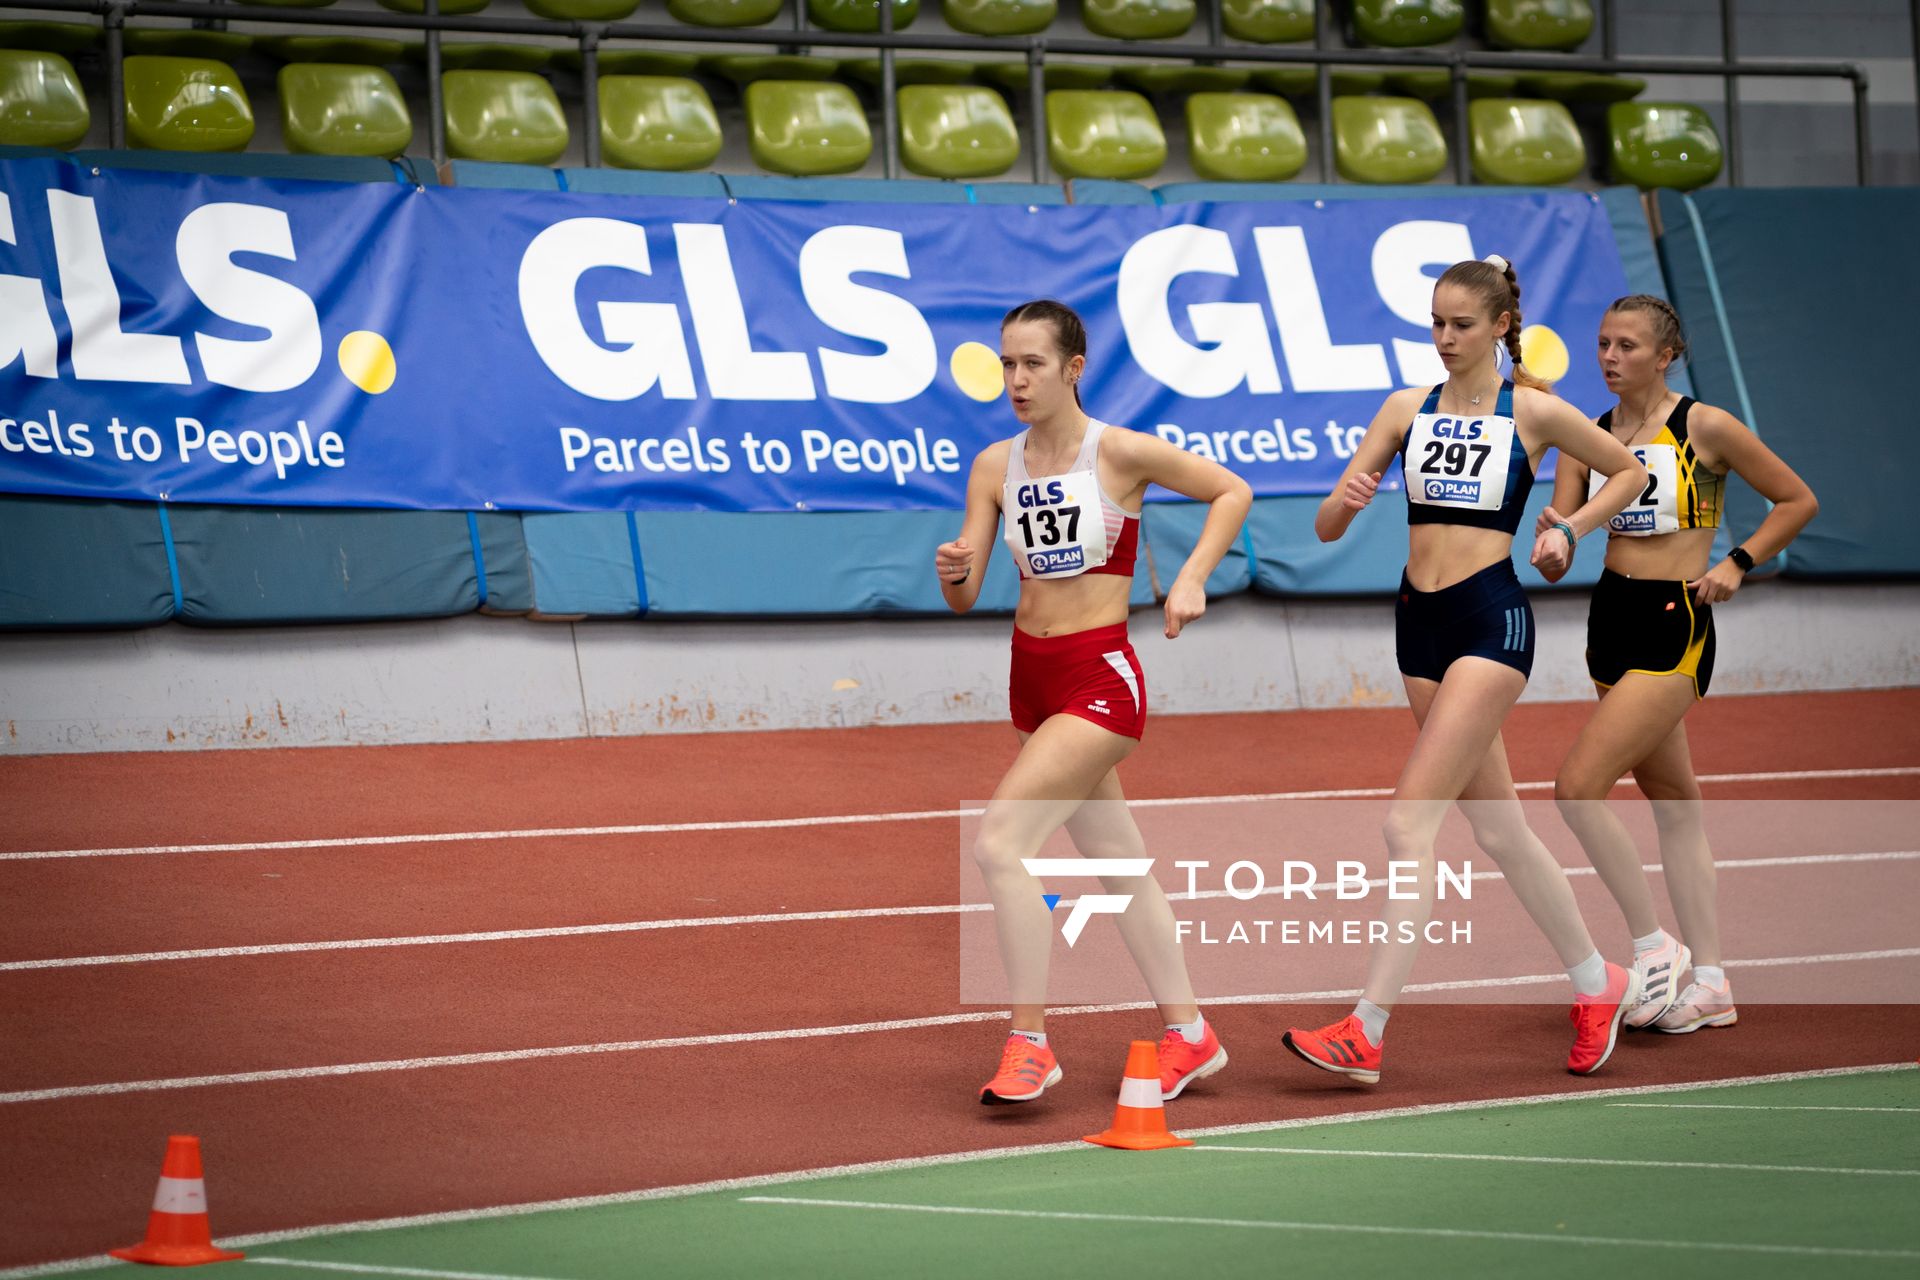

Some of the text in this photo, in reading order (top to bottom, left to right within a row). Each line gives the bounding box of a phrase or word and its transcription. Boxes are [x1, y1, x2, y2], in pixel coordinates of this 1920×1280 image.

[0, 188, 397, 394] LS.
[107, 417, 162, 462] to
[175, 417, 345, 480] People
[560, 426, 960, 485] Parcels to People
[1155, 418, 1318, 464] Parcels
[1420, 441, 1492, 477] 297
[1445, 483, 1478, 495] PLAN
[1638, 473, 1659, 506] 2
[1017, 505, 1081, 548] 137
[1626, 513, 1653, 524] PLAN
[1049, 551, 1081, 564] PLAN
[1087, 704, 1110, 715] erima
